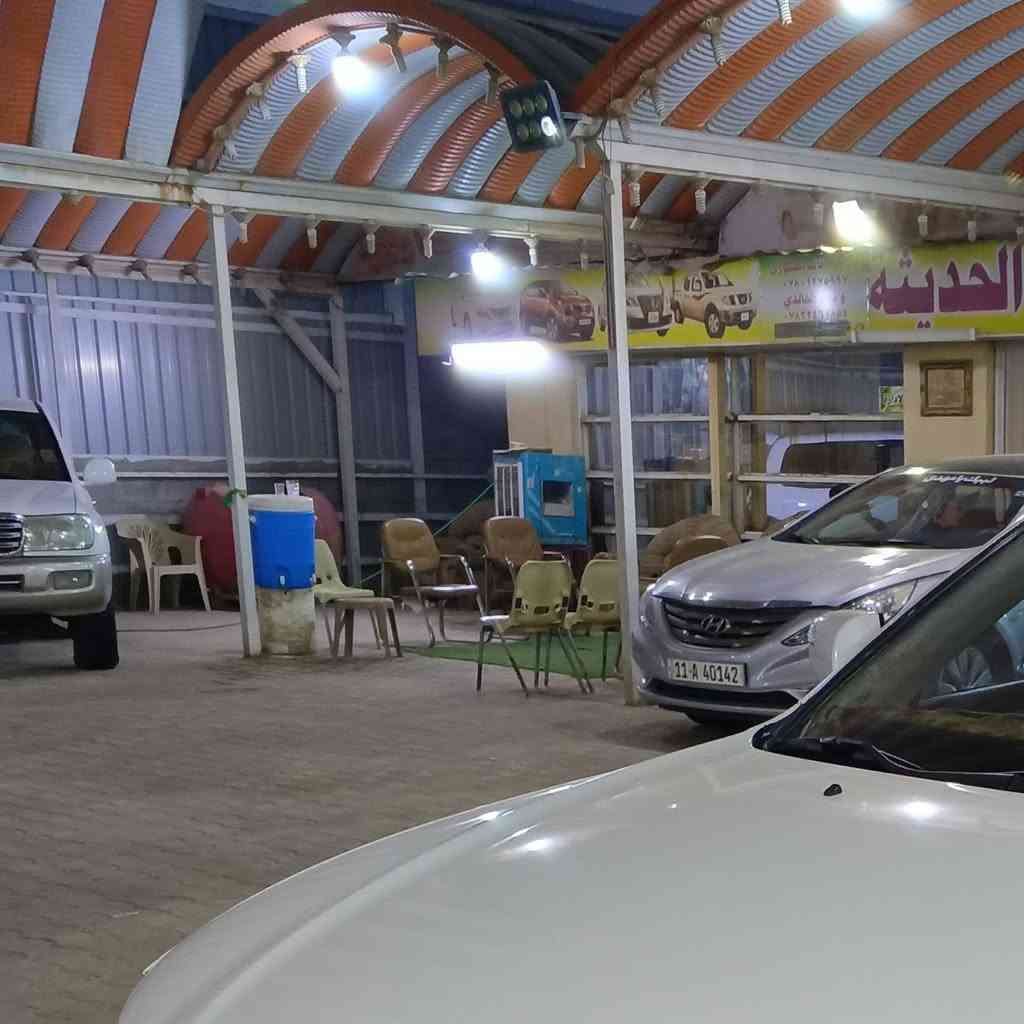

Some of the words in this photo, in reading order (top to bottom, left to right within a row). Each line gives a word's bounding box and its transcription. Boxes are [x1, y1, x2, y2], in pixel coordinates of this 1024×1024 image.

[674, 662, 687, 679] 11
[692, 663, 699, 680] A
[703, 664, 739, 684] 40142
